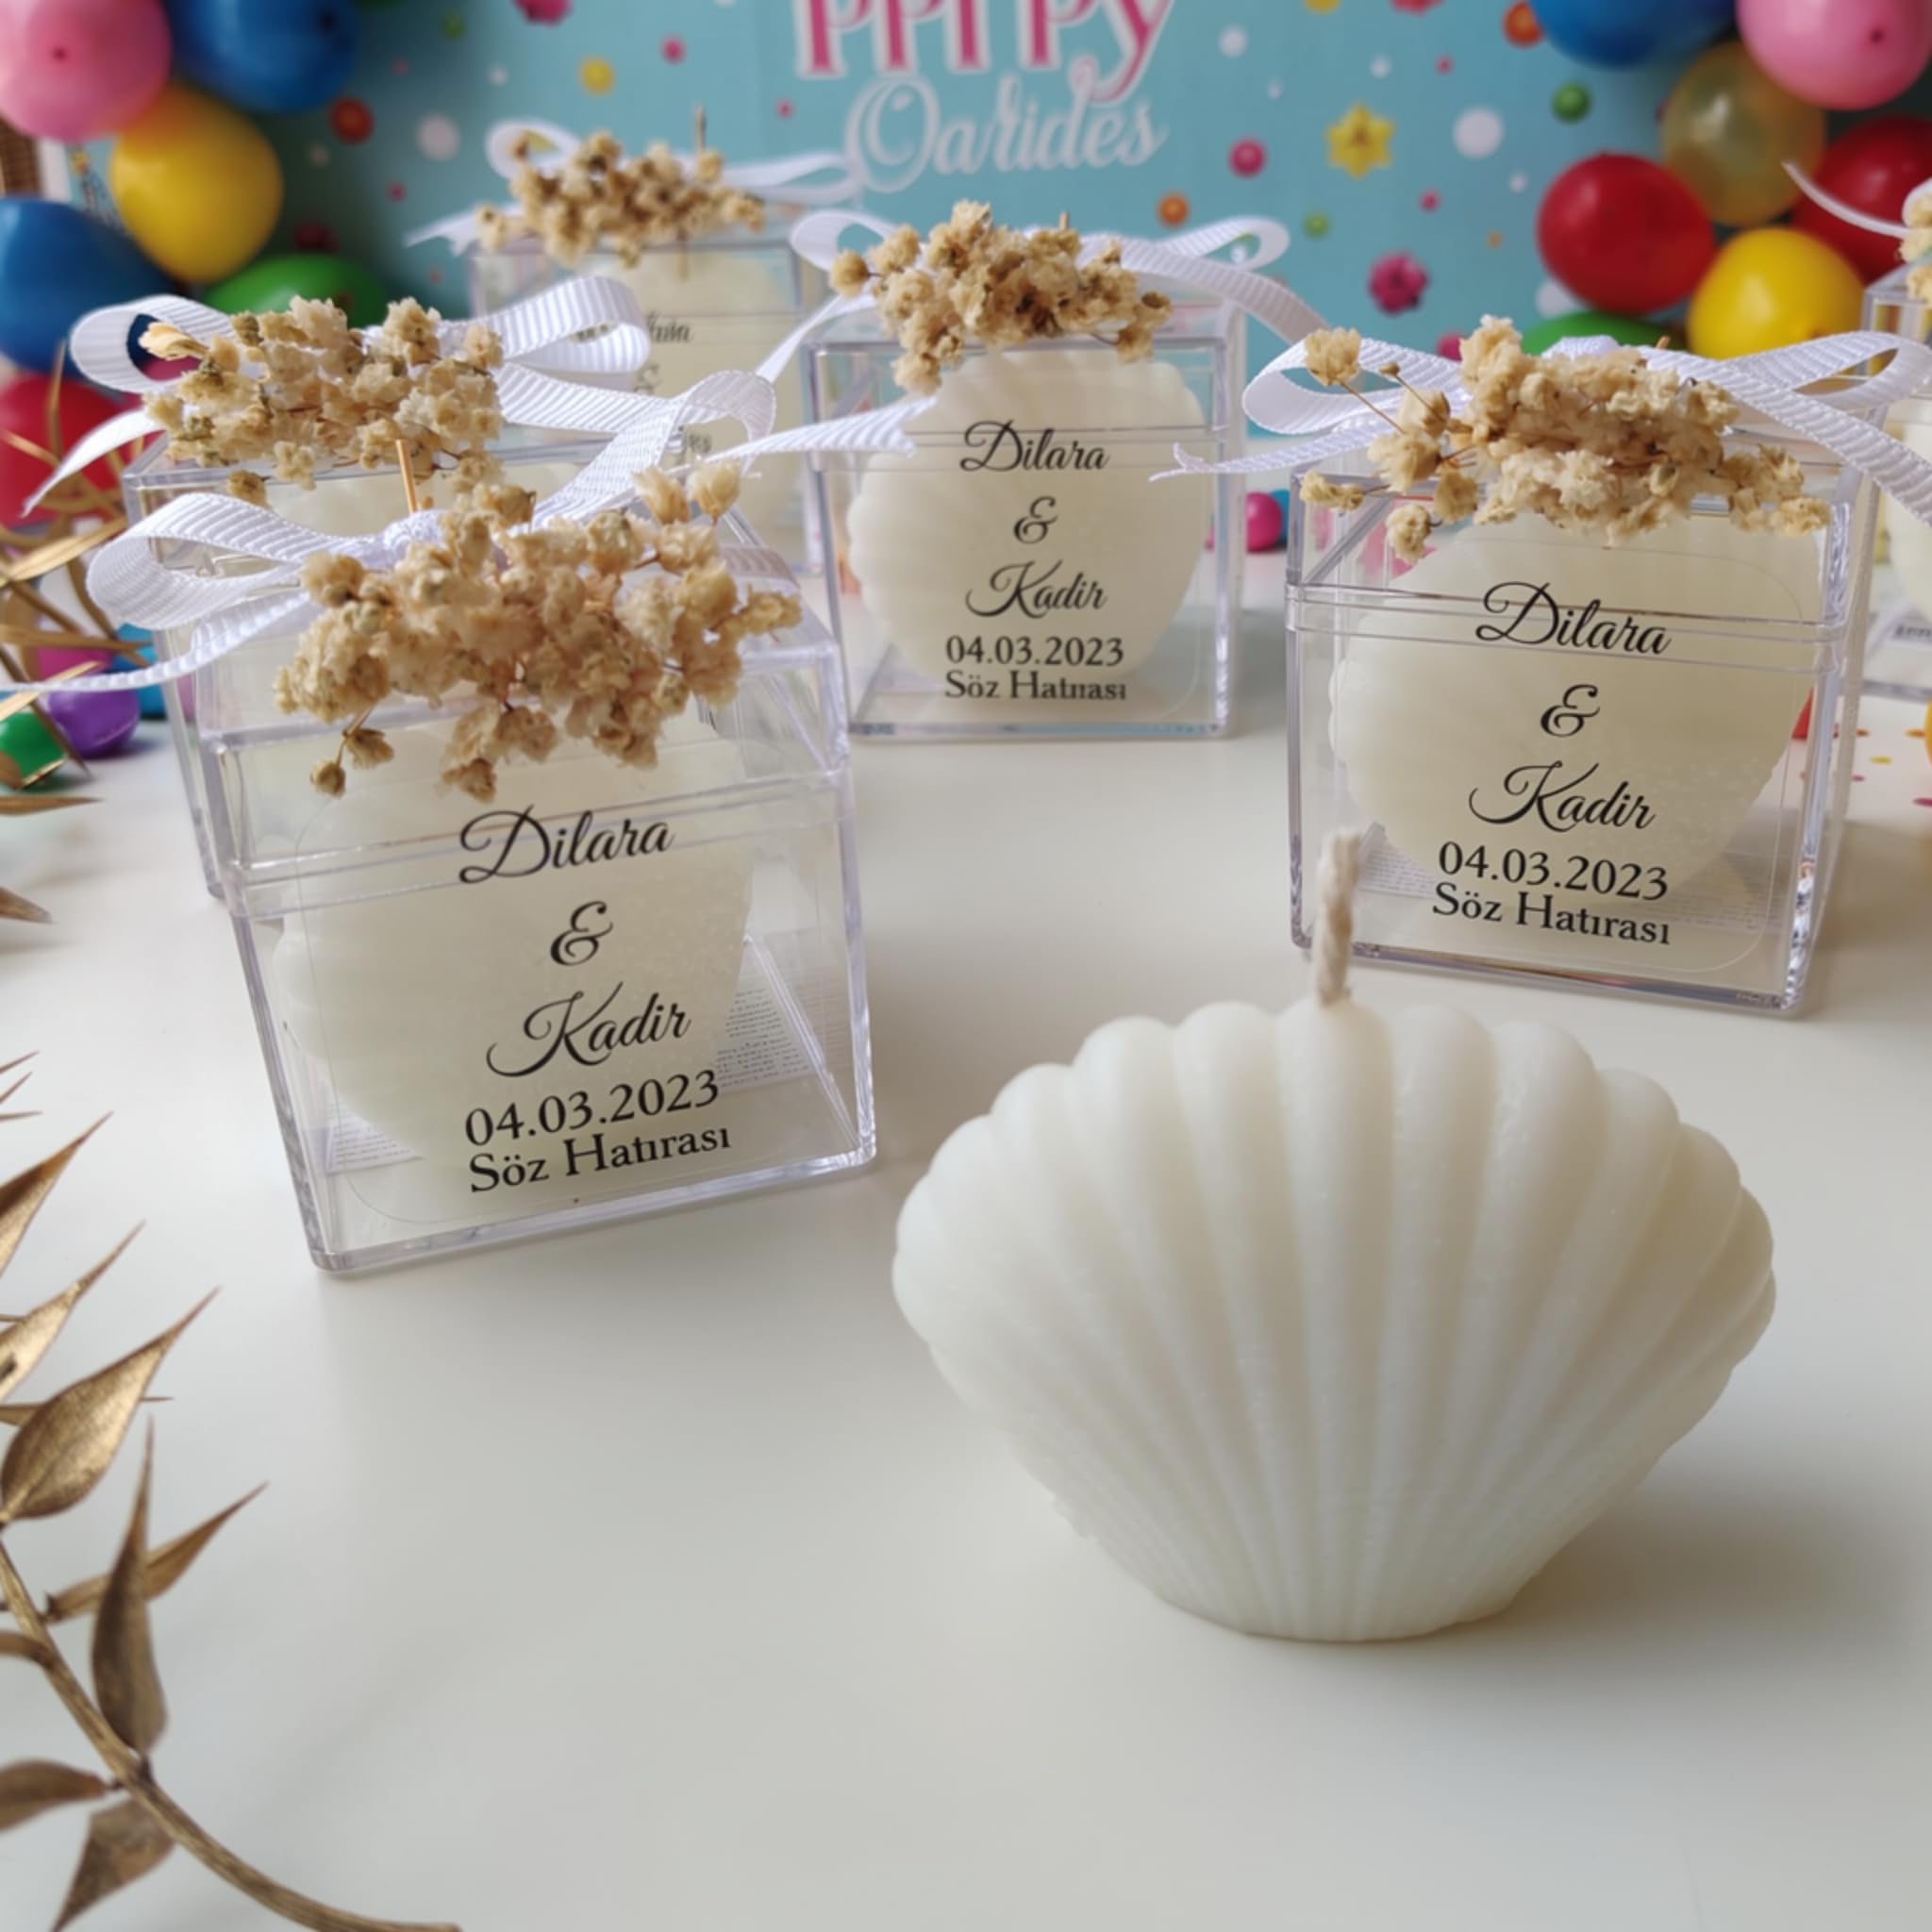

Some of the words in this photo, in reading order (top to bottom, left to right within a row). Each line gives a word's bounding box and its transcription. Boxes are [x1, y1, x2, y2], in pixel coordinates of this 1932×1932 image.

[959, 420, 1109, 472] Dilara
[1013, 495, 1058, 544] &
[965, 559, 1108, 619] Kadir
[1475, 581, 1672, 655] Dilara
[945, 635, 1124, 666] 04.03.2023
[945, 669, 1000, 698] Söz
[1541, 684, 1601, 737] &
[1469, 760, 1657, 832] Kadir
[459, 804, 675, 884] Dilara
[1439, 841, 1668, 901] 04.03.2023
[550, 900, 613, 966] &
[1432, 882, 1503, 922] Söz
[1515, 891, 1671, 944] Hatırası
[486, 981, 691, 1077] Kadir
[465, 1069, 720, 1146] 04.03.2023
[469, 1154, 550, 1193] Söz
[563, 1128, 731, 1176] Hatırası
